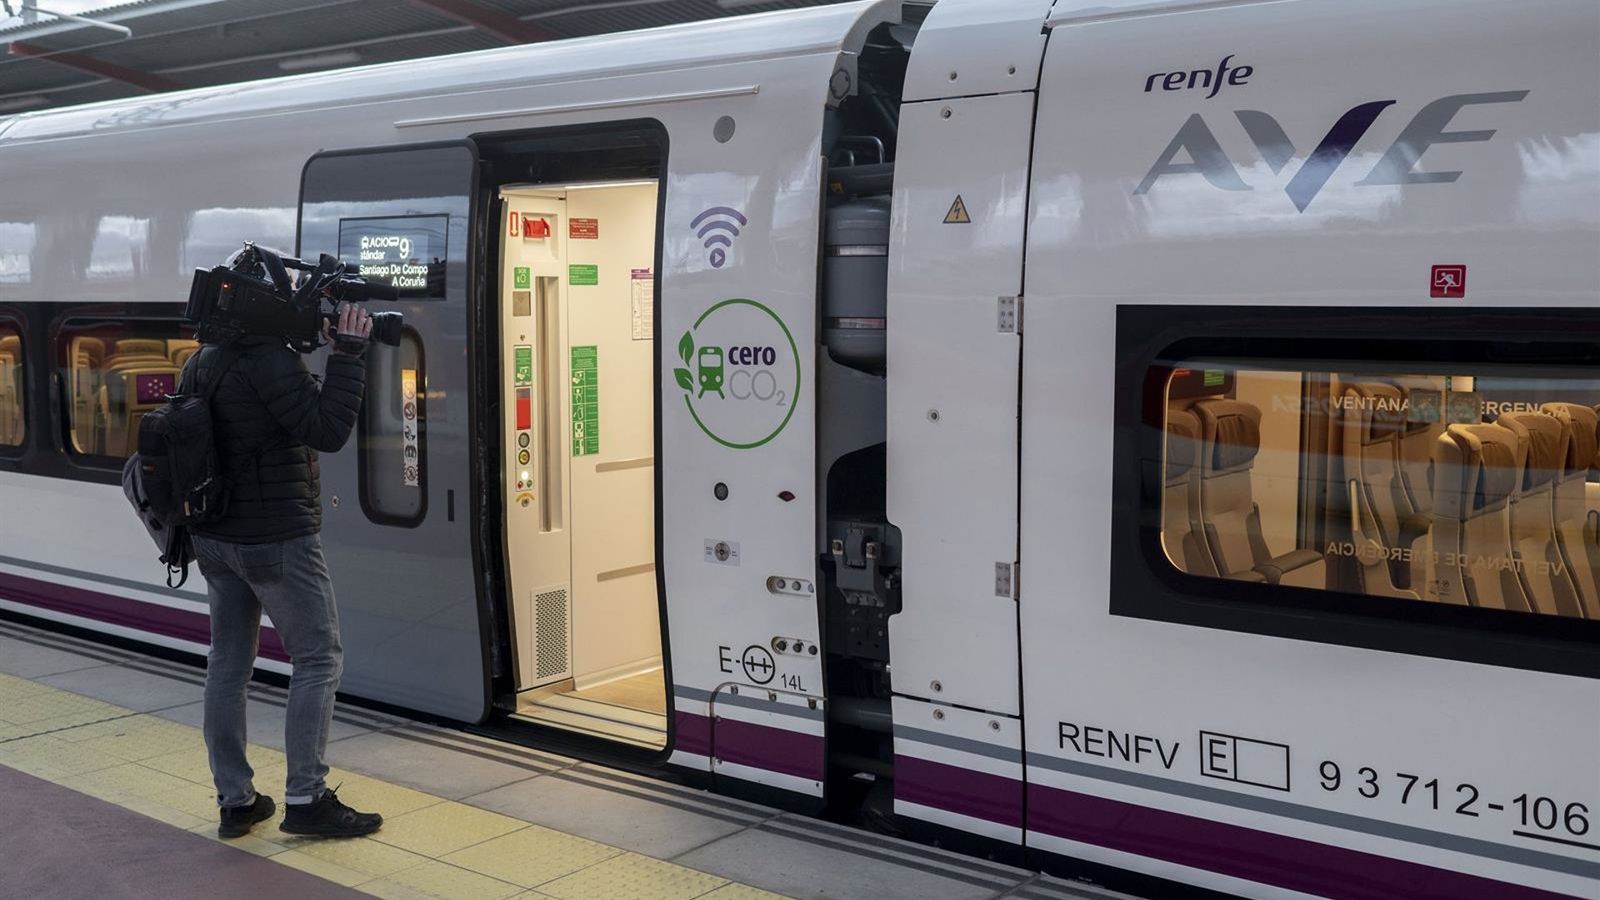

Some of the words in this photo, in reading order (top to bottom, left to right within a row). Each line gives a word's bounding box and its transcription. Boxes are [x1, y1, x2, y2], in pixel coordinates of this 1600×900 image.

[1144, 54, 1254, 99] renfe
[1132, 90, 1531, 213] AVE
[399, 238, 410, 259] 9
[360, 265, 389, 277] Santiago
[390, 264, 401, 274] De
[391, 277, 398, 287] A
[399, 276, 425, 287] Coruña
[728, 346, 777, 365] cero
[780, 673, 807, 692] 14L
[1058, 721, 1180, 769] RENFV
[1209, 739, 1229, 773] E
